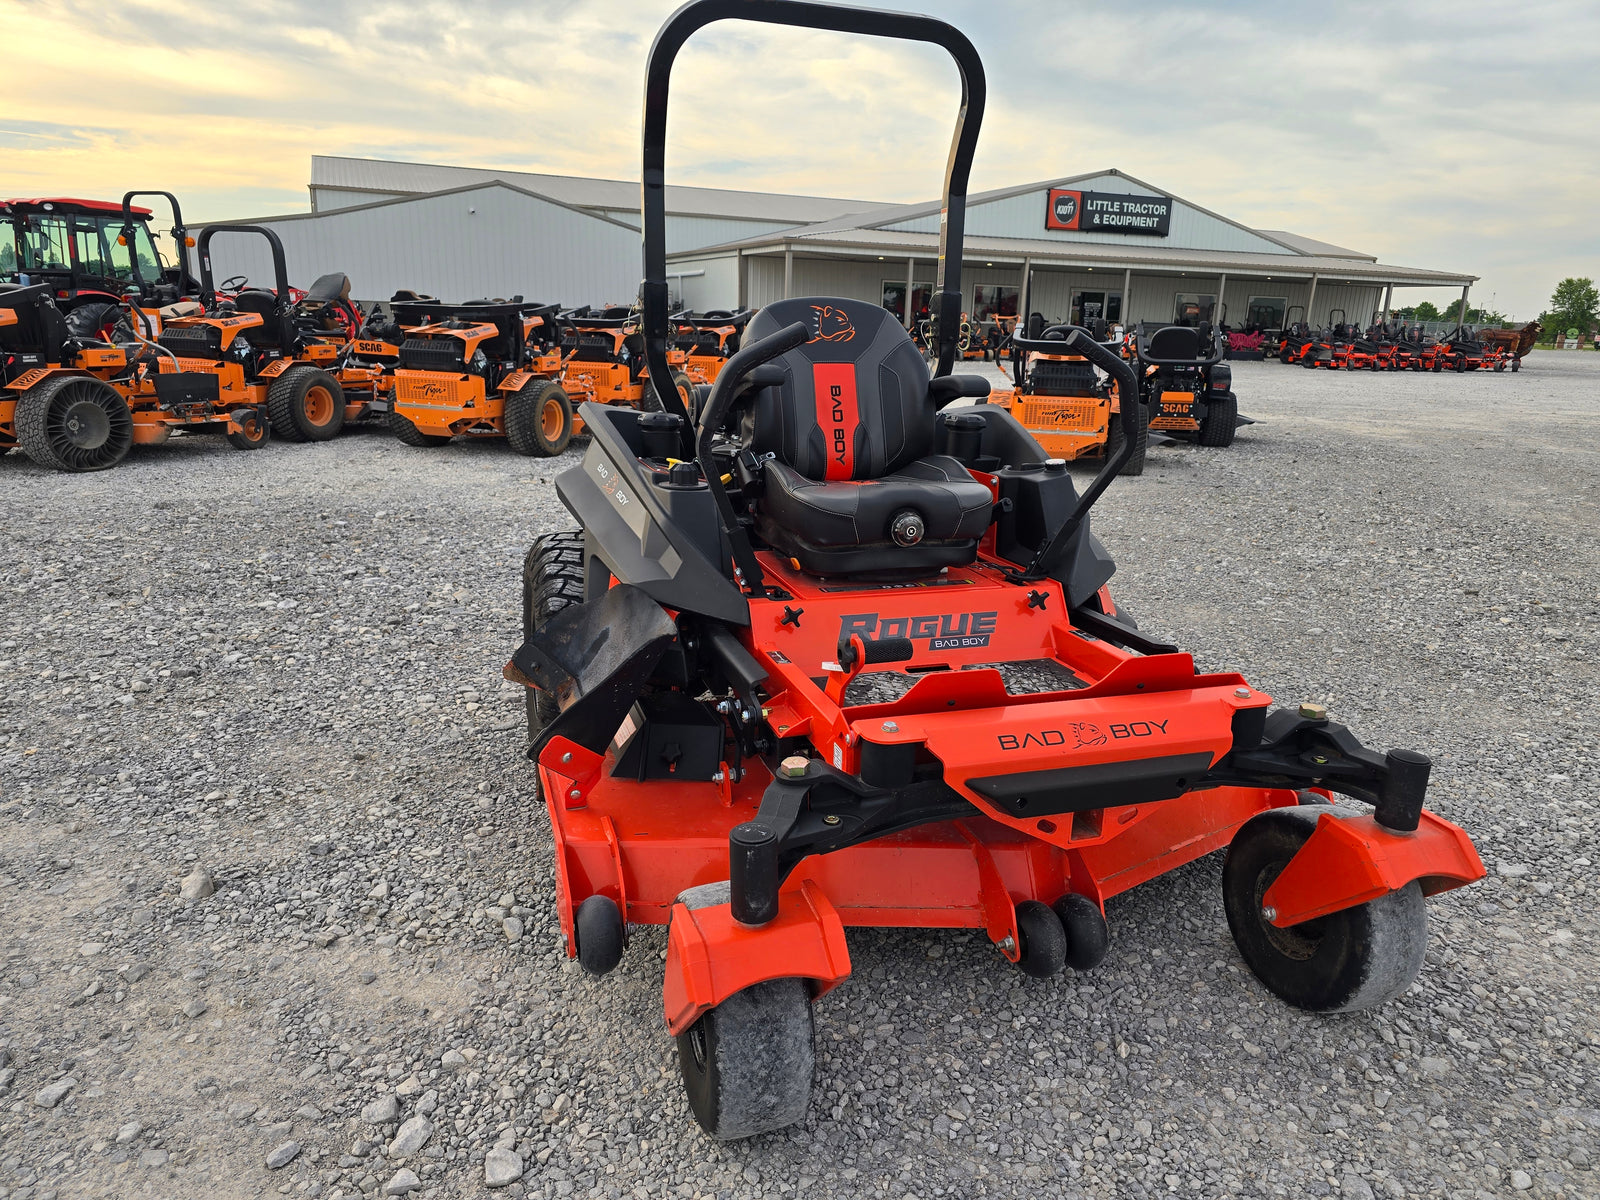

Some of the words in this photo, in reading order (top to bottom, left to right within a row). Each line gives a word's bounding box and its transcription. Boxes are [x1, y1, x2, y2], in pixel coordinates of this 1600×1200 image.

[1087, 200, 1120, 212] LITTLE
[1122, 202, 1167, 215] TRACTOR
[1093, 213, 1101, 224] &
[1103, 214, 1159, 228] EQUIPMENT
[358, 342, 383, 353] SCAG
[830, 385, 843, 422] BAD
[1162, 403, 1190, 413] SCAG
[834, 429, 846, 466] BOY
[597, 463, 608, 479] BAD
[615, 490, 629, 506] BOY
[934, 639, 959, 648] BAD
[962, 637, 985, 646] BOY
[998, 730, 1065, 750] BAD
[1109, 719, 1169, 739] BOY
